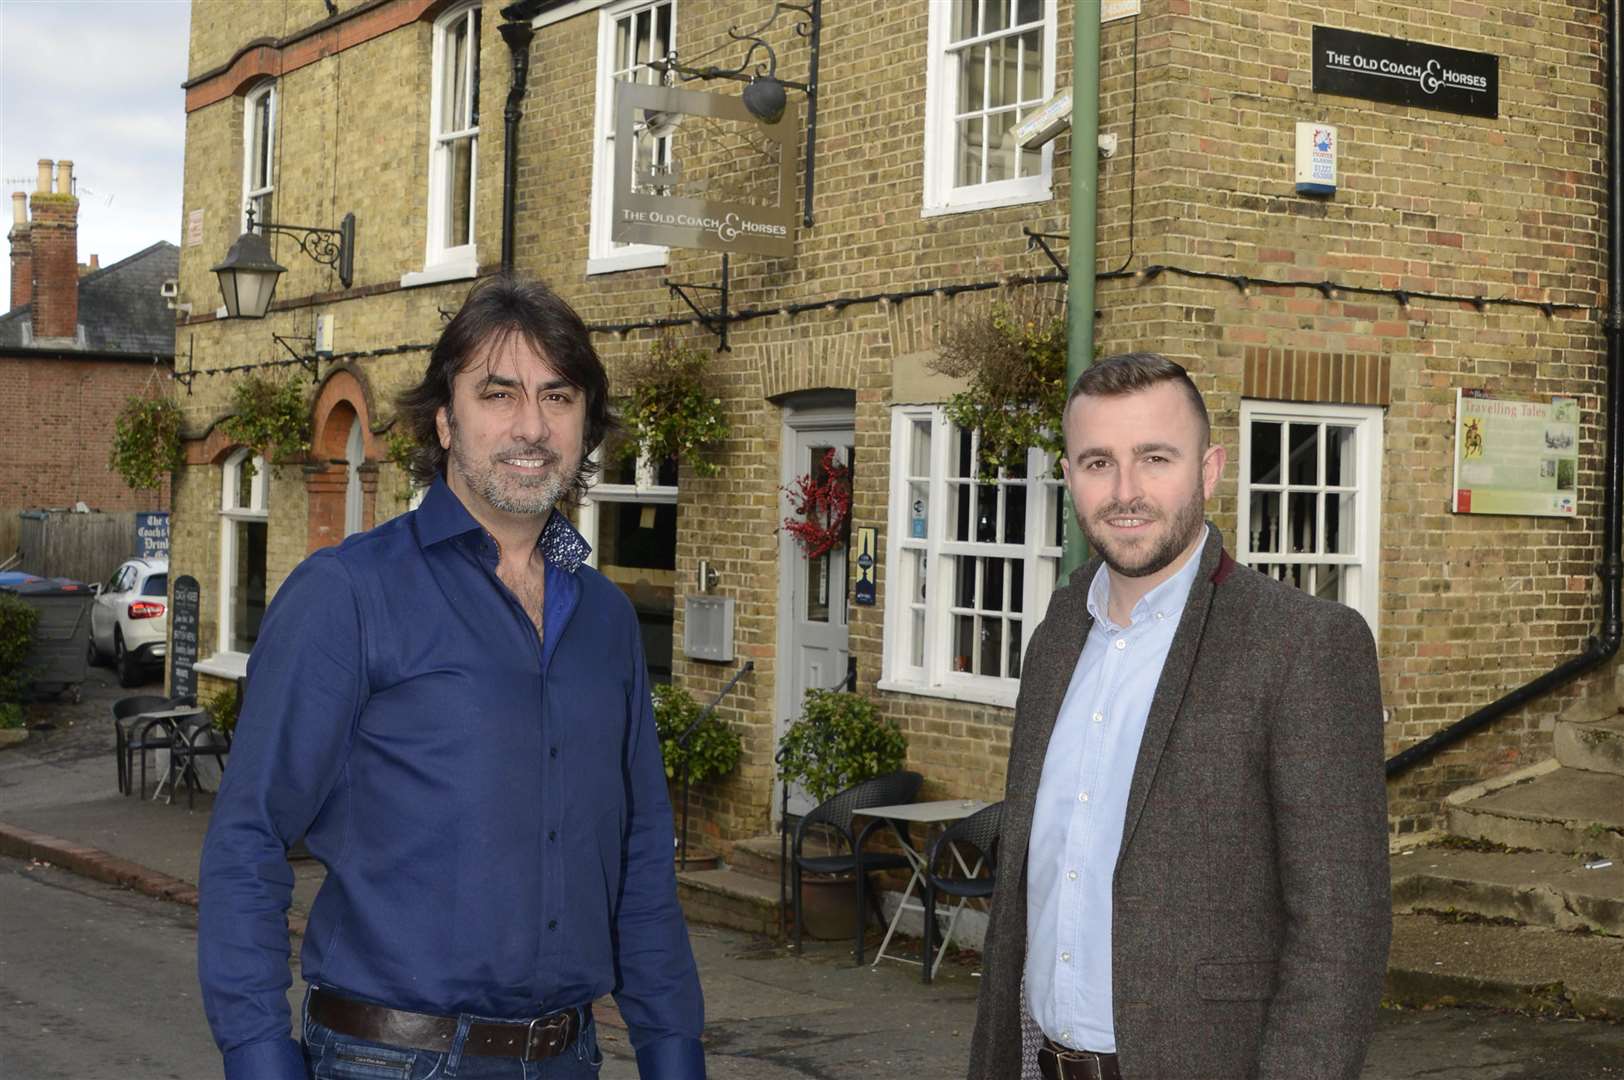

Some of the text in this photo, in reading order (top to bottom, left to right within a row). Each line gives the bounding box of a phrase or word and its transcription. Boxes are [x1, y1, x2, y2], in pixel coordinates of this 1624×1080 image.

[1326, 51, 1487, 94] THE OLD COACH & HORSES
[677, 214, 719, 228] COACH
[741, 221, 787, 235] HORSES
[1465, 400, 1547, 418] Travelling Tales
